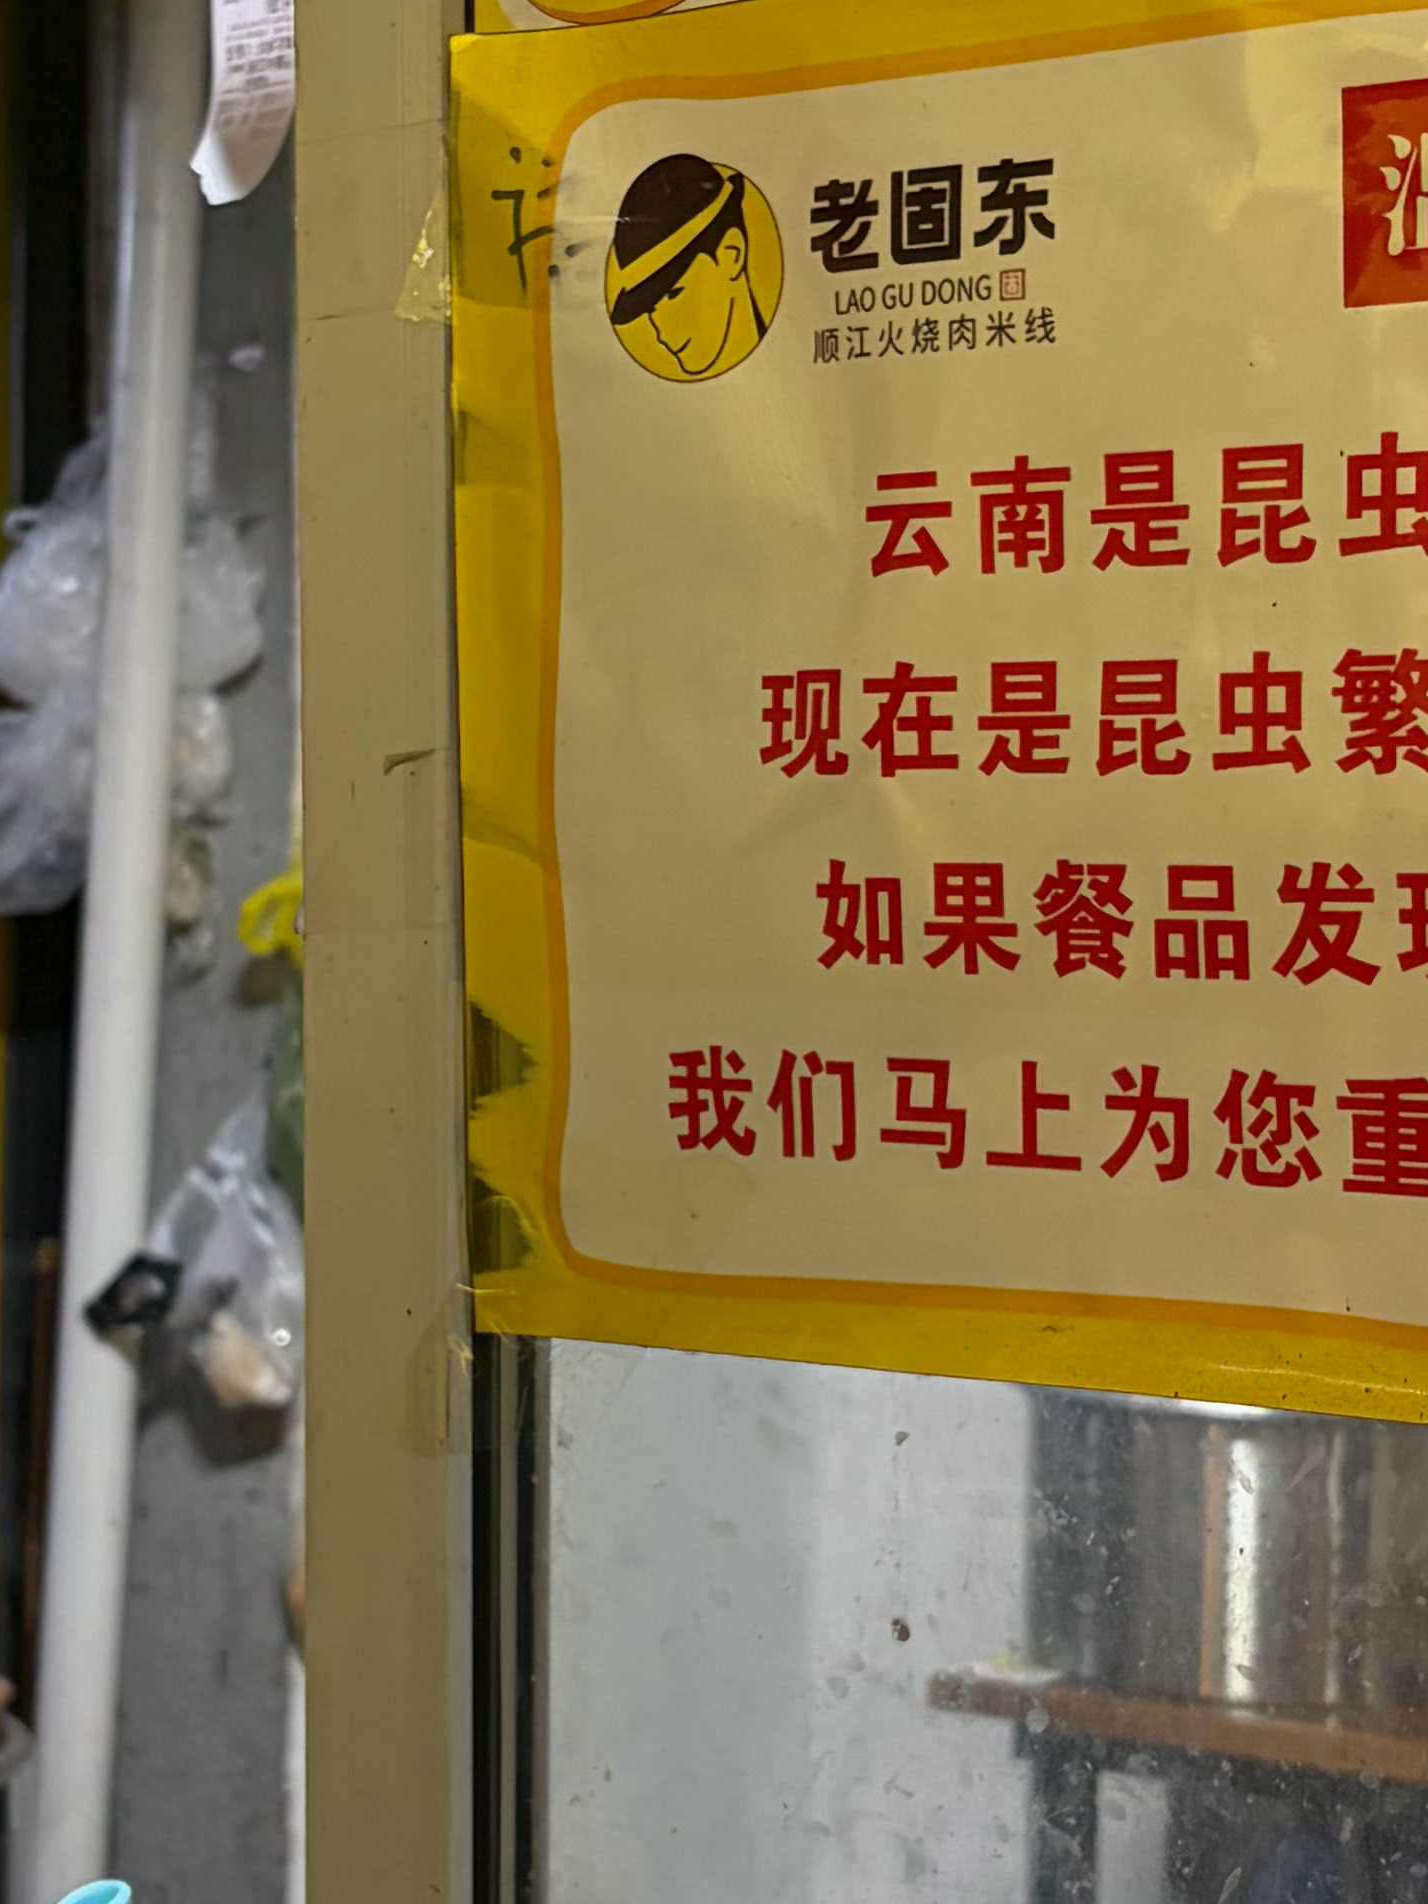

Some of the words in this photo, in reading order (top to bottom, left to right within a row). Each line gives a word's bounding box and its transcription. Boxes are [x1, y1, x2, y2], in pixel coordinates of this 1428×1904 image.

[809, 157, 1056, 274] 老固东
[834, 286, 877, 316] LAO
[882, 282, 914, 310] GU
[922, 274, 992, 307] DONG
[813, 306, 1057, 364] 顺江火烧肉米线
